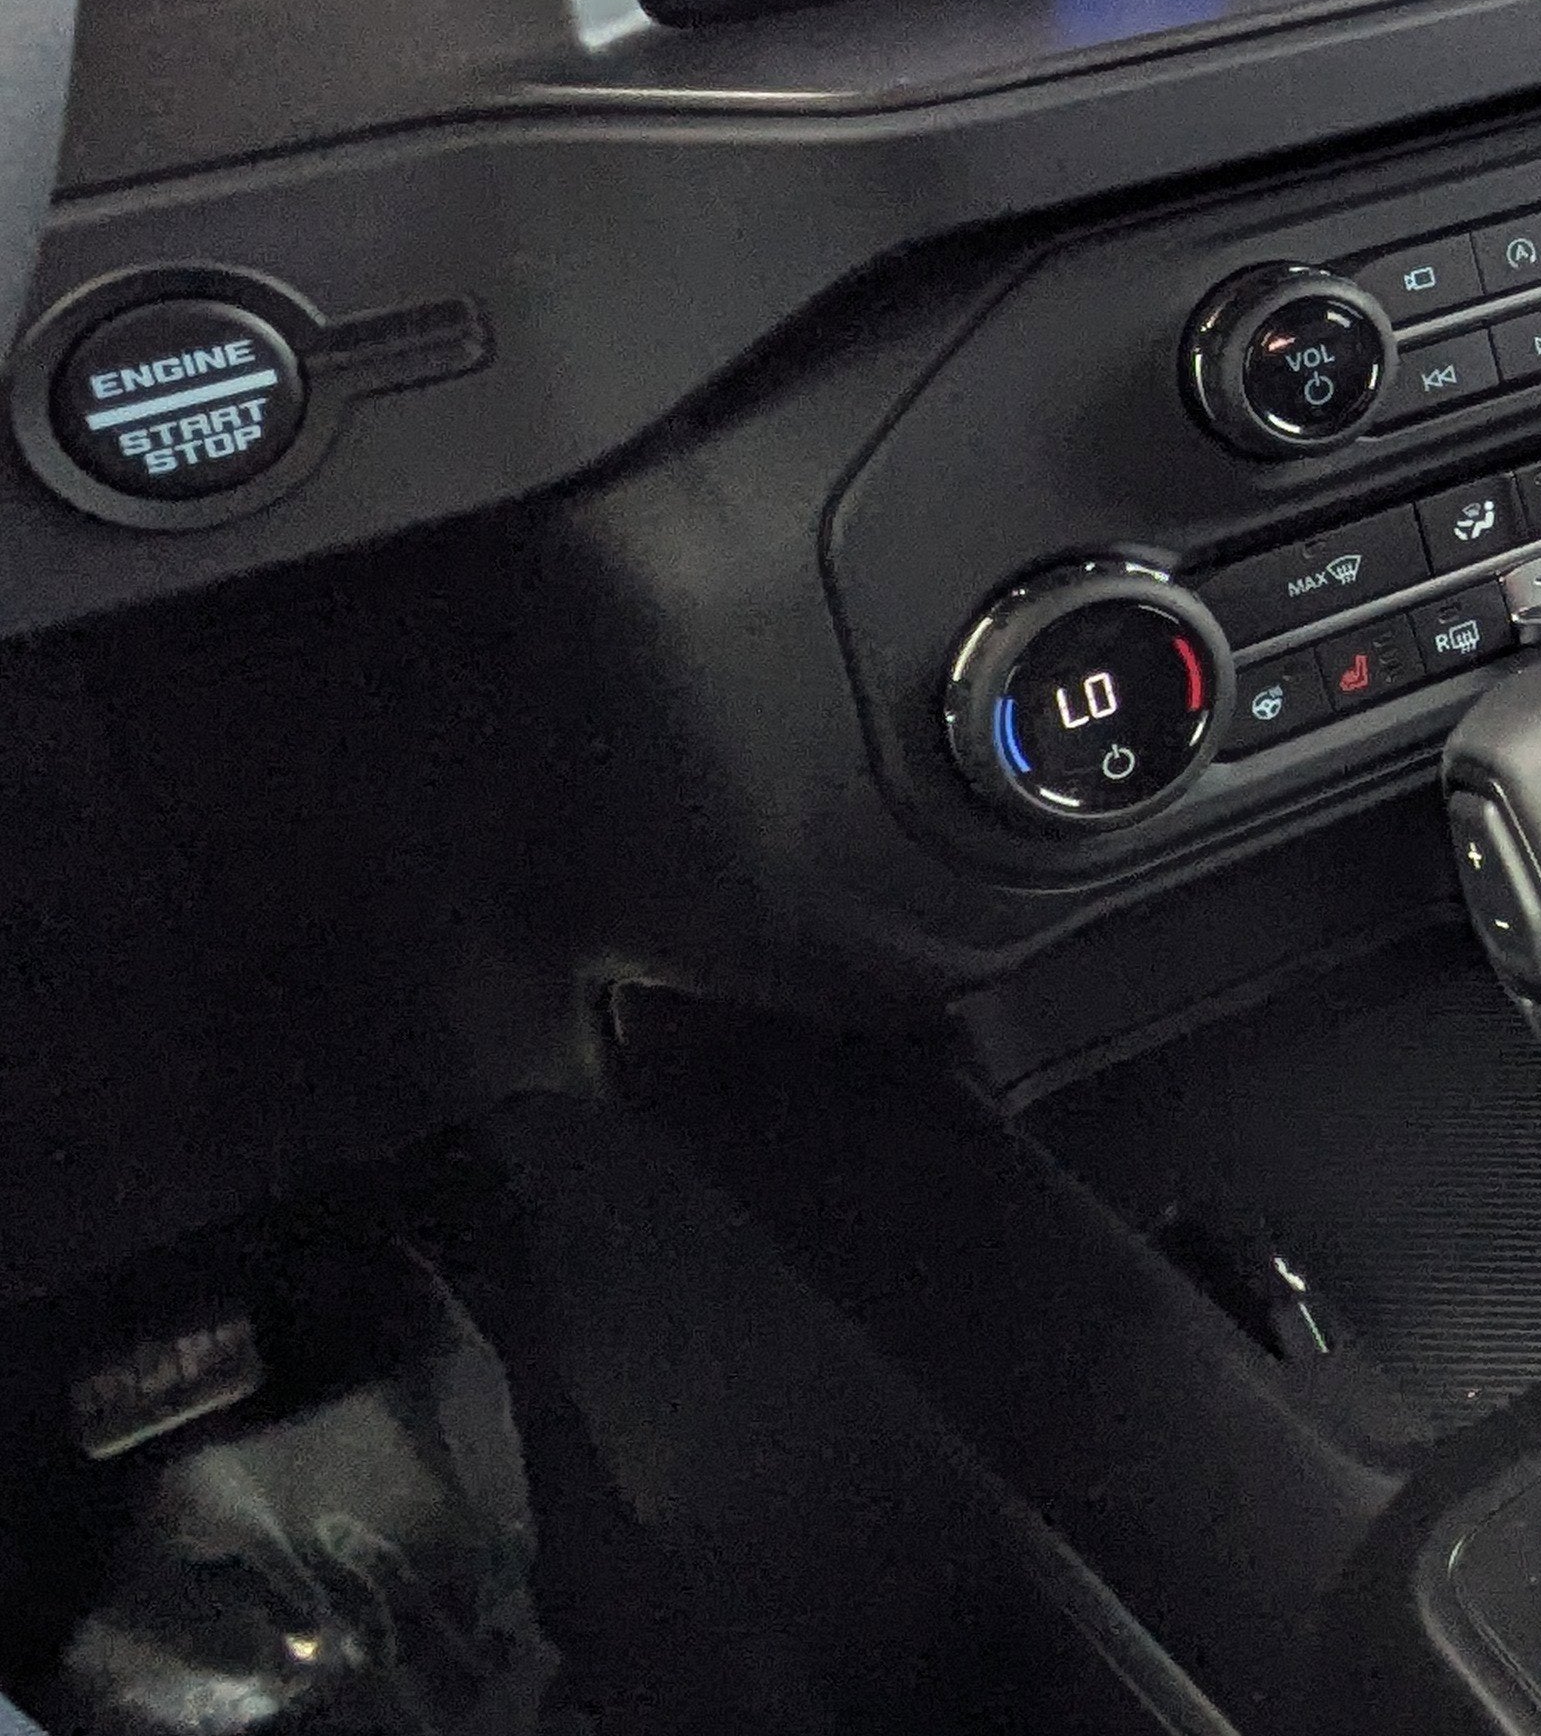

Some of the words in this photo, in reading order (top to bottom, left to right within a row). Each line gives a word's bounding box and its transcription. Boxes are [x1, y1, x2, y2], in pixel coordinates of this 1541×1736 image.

[90, 338, 256, 400] ENGINE
[1285, 347, 1336, 374] VOL
[118, 398, 268, 457] START
[143, 424, 263, 476] STOP
[1288, 570, 1329, 597] MAX
